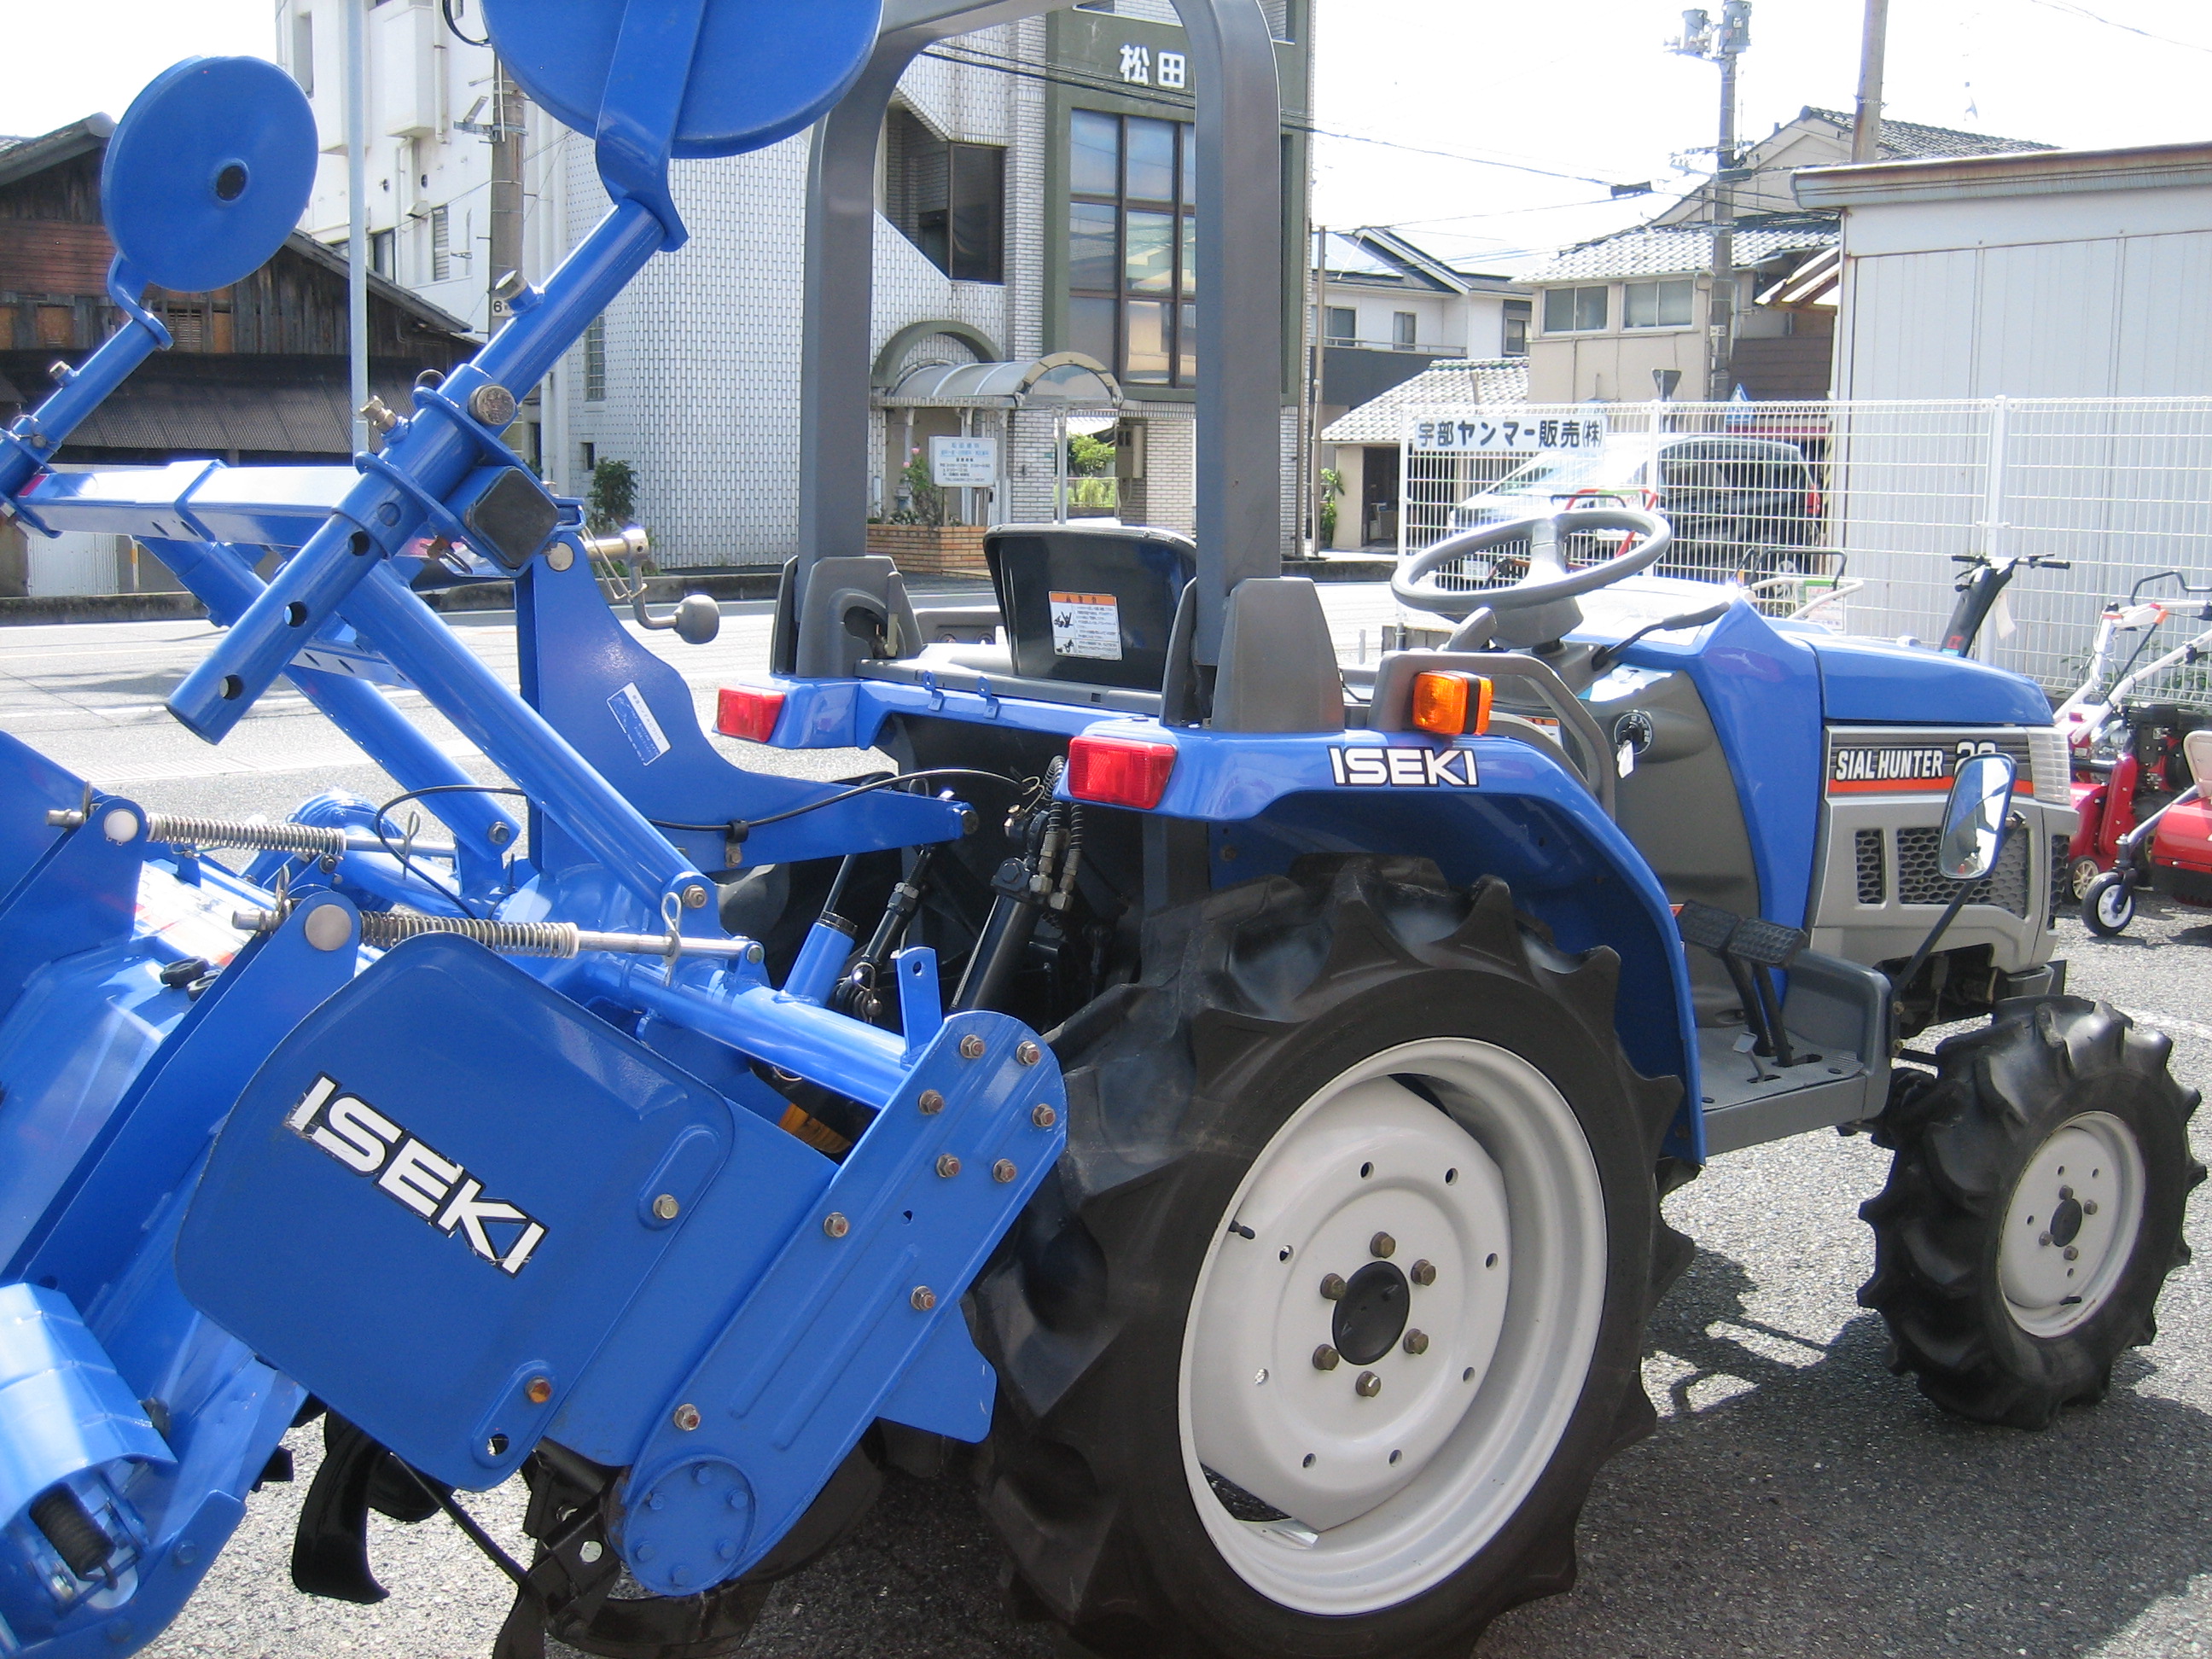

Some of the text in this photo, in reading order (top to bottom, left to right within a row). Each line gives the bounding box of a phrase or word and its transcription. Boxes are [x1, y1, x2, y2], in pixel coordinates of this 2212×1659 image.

[1120, 44, 1185, 89] 松田
[1329, 748, 1477, 786] ISEKI
[1836, 749, 1876, 781] SIAL
[1877, 749, 1943, 779] HUNTER
[290, 1075, 546, 1275] ISEKI
